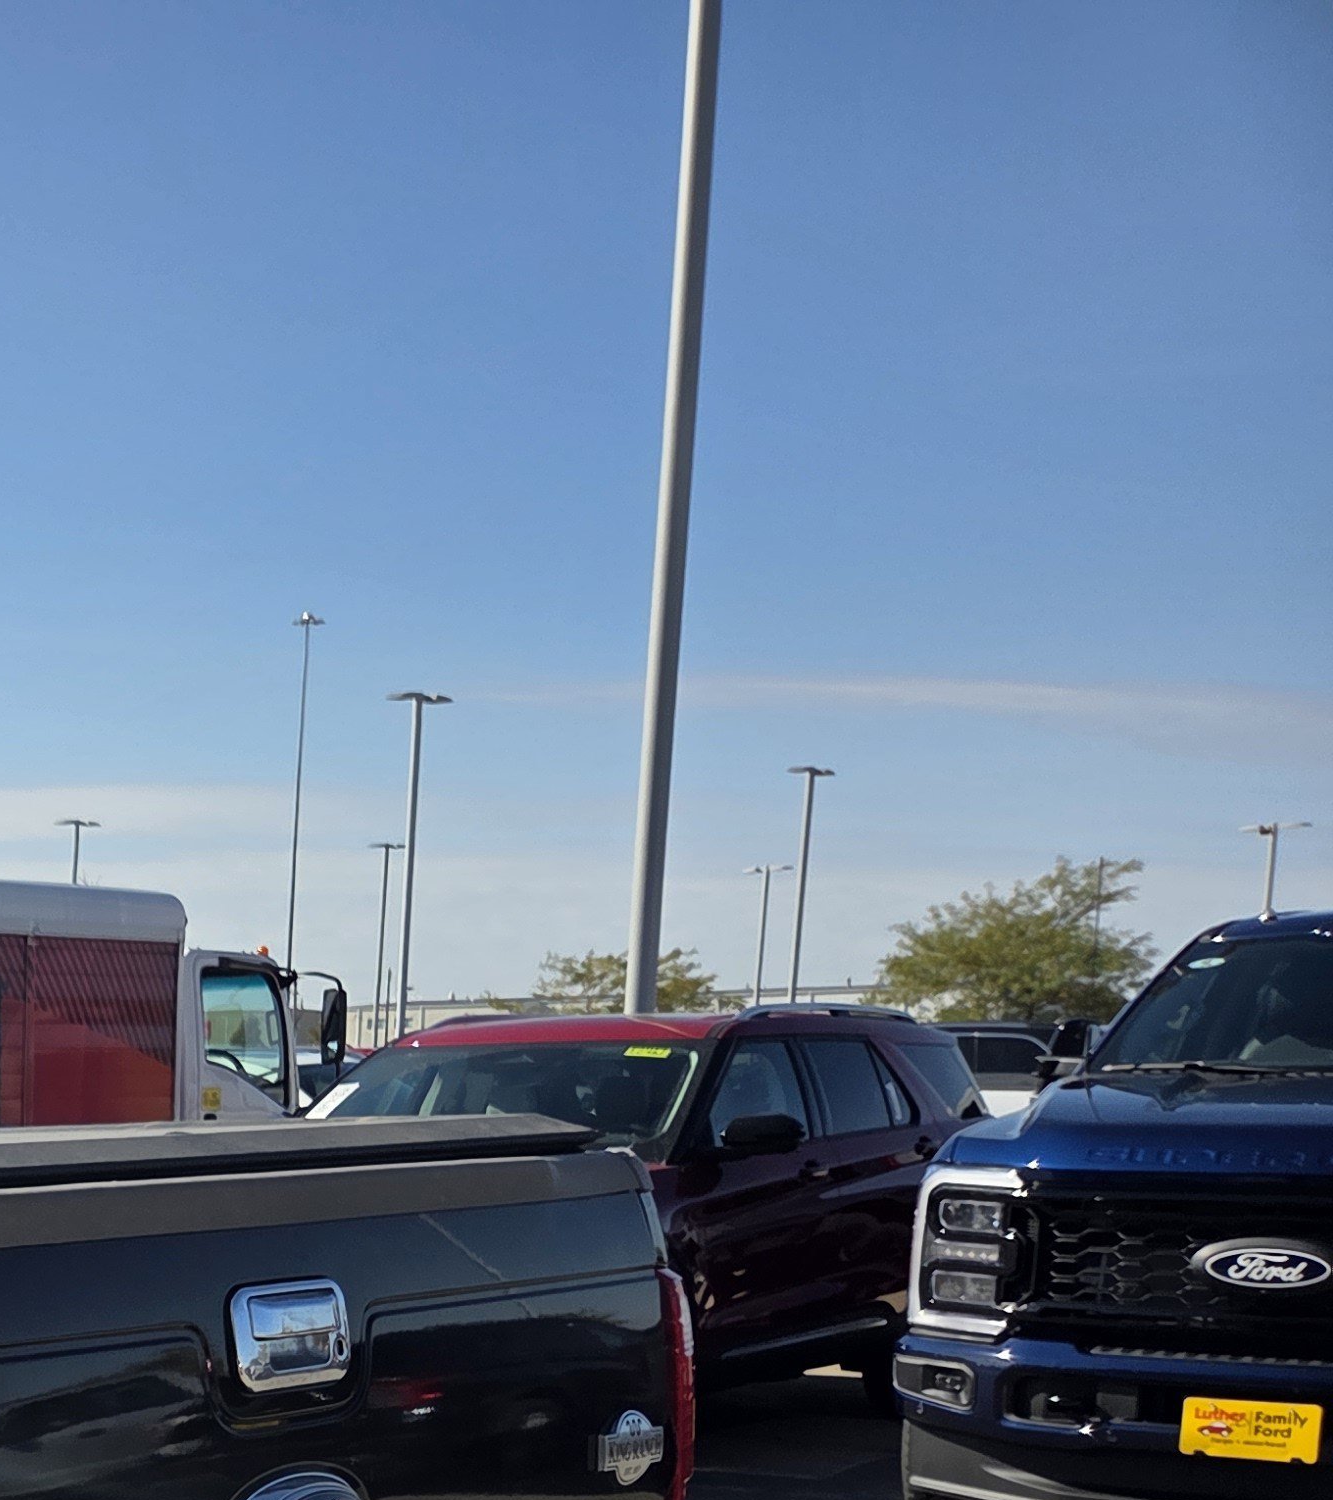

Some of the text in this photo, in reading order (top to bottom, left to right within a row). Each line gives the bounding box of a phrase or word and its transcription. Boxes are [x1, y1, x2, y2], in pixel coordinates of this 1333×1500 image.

[1227, 1253, 1308, 1283] Ford
[1255, 1408, 1309, 1429] Family
[1253, 1425, 1293, 1439] Ford
